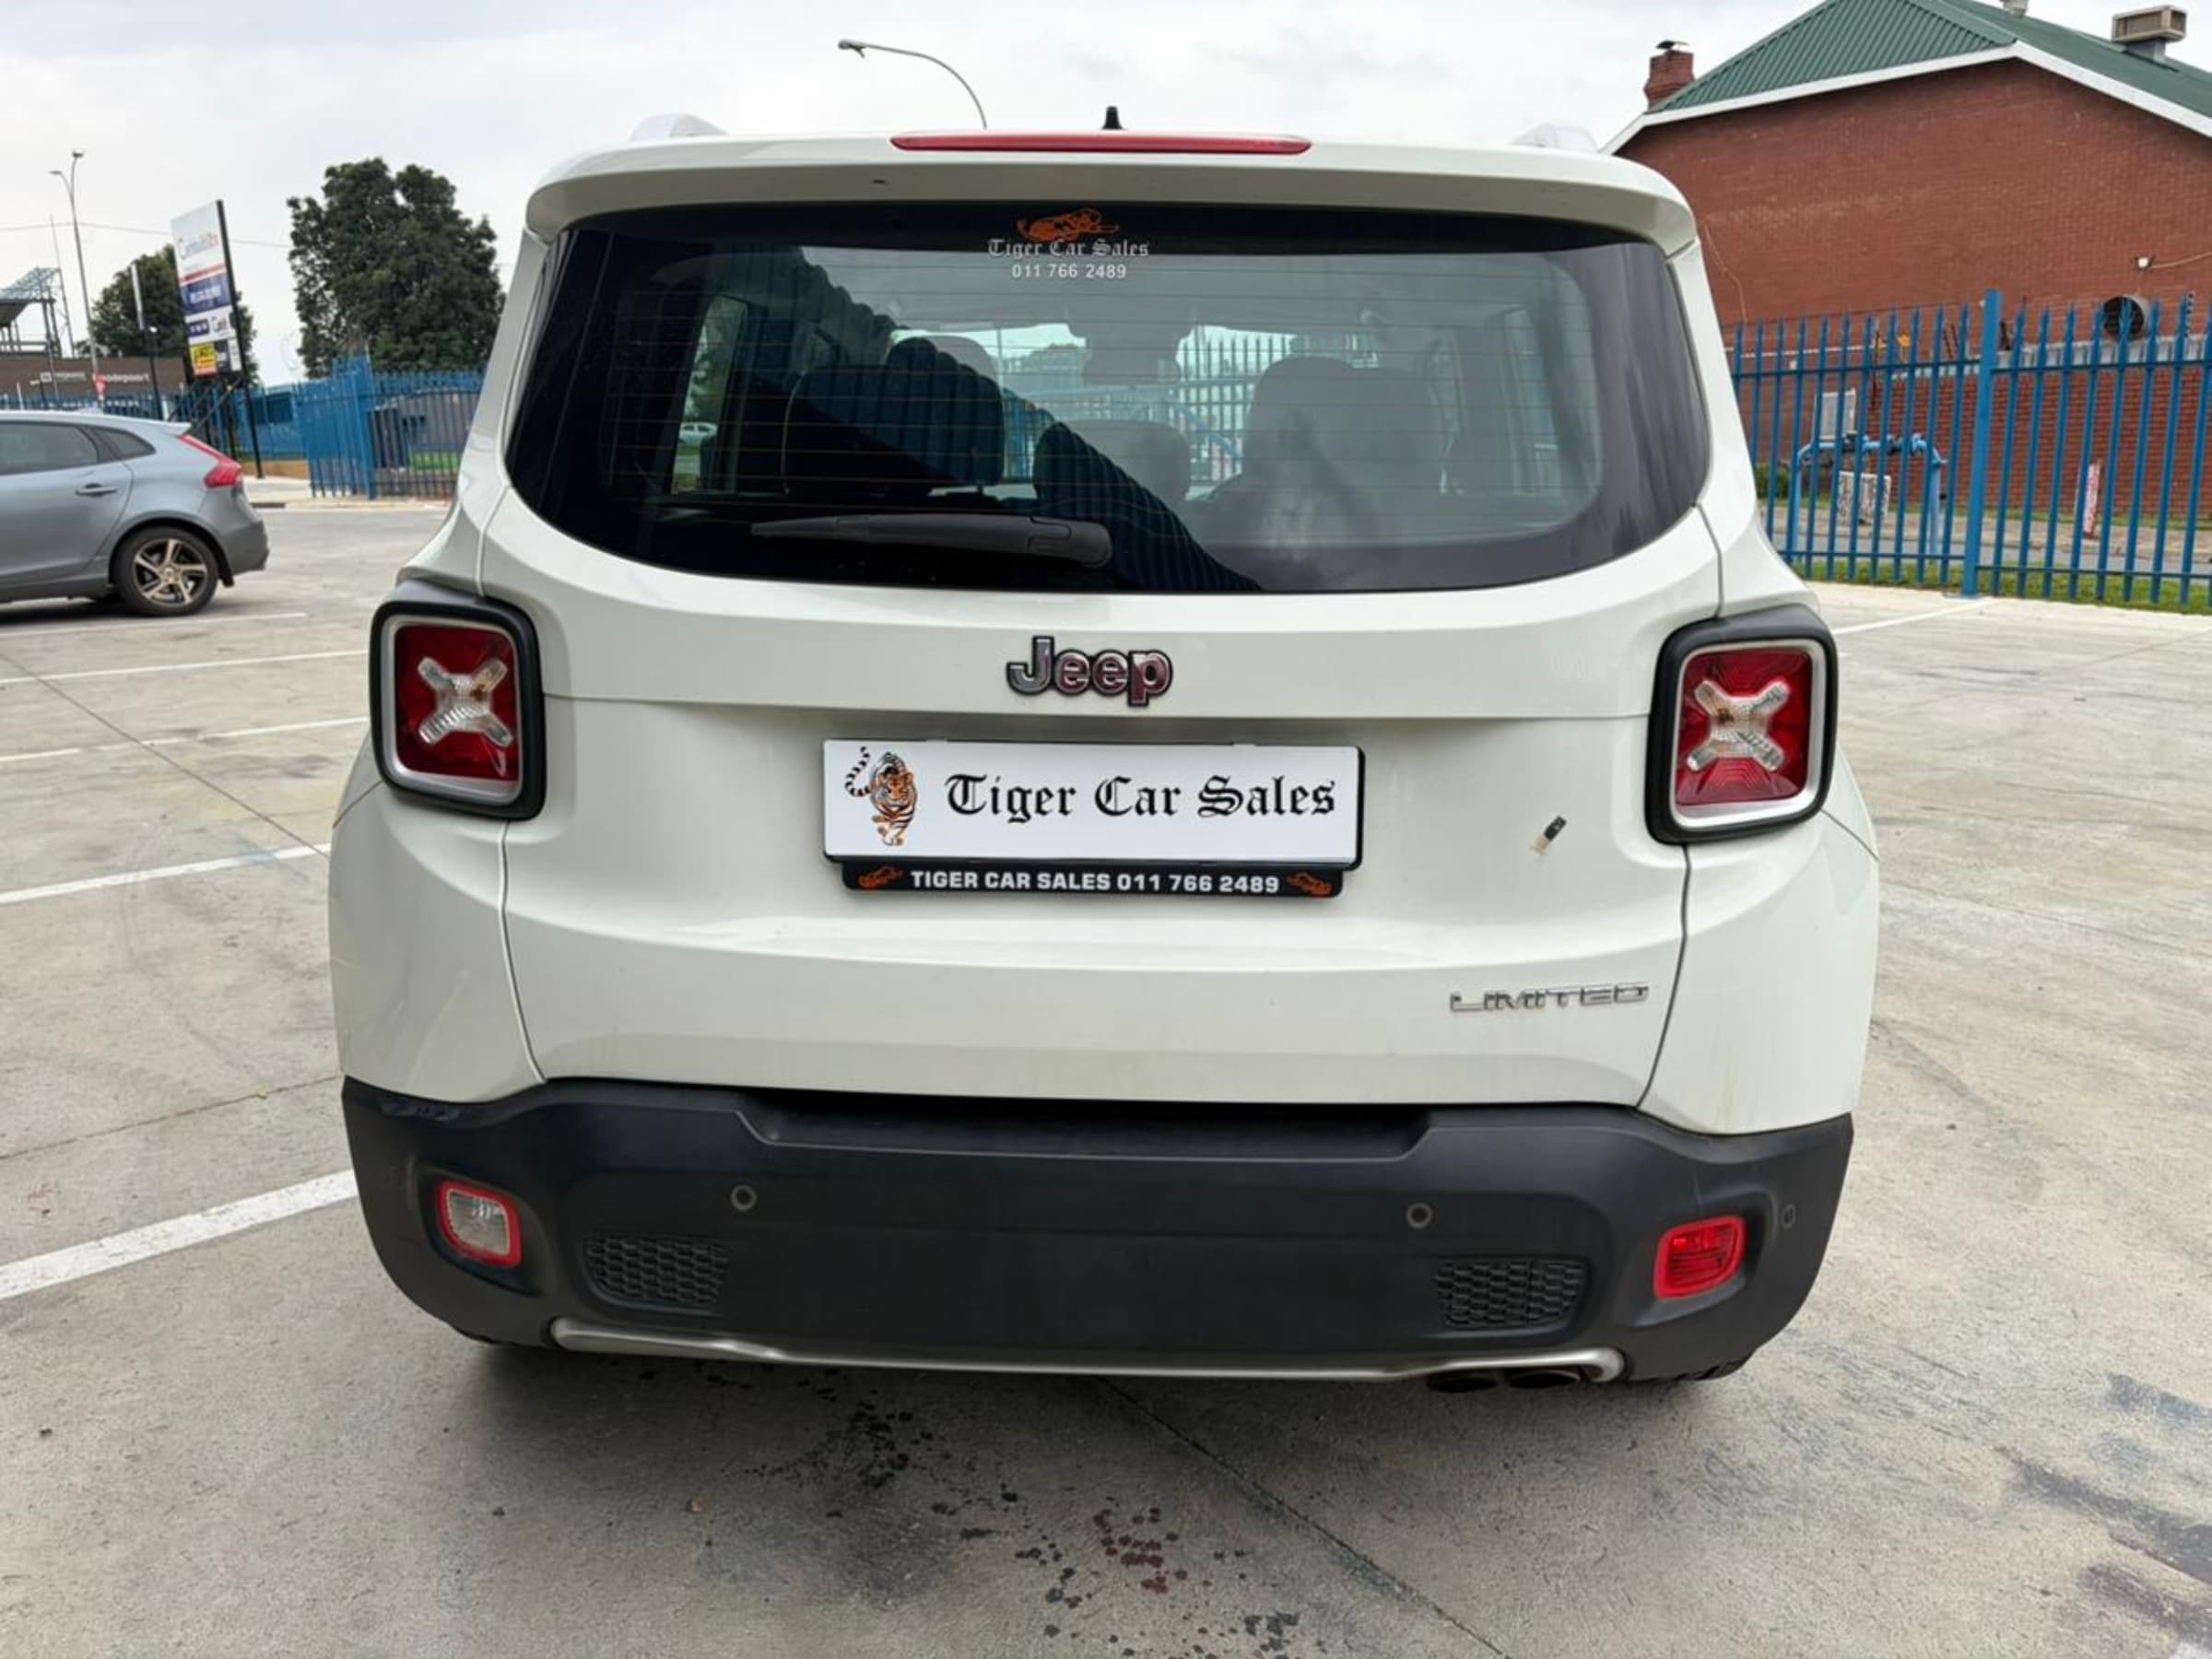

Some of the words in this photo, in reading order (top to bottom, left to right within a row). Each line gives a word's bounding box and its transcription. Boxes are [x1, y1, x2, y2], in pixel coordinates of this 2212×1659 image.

[987, 238, 1042, 260] Tiger
[1049, 238, 1087, 256] Car
[1091, 238, 1149, 256] Sales
[1012, 264, 1041, 278] 011
[1048, 264, 1078, 278] 766
[1086, 264, 1127, 278] 2489
[1006, 636, 1172, 707] Jeep
[945, 773, 1077, 823] Tiger
[1094, 776, 1182, 818] Car
[1197, 775, 1335, 818] Sales
[911, 871, 979, 889] TIGER
[984, 872, 1032, 889] CAR
[1037, 873, 1112, 891] SALES
[1117, 874, 1161, 891] 011
[1170, 875, 1213, 892] 766
[1219, 876, 1279, 893] 2489
[1450, 983, 1649, 1013] LIMITED
